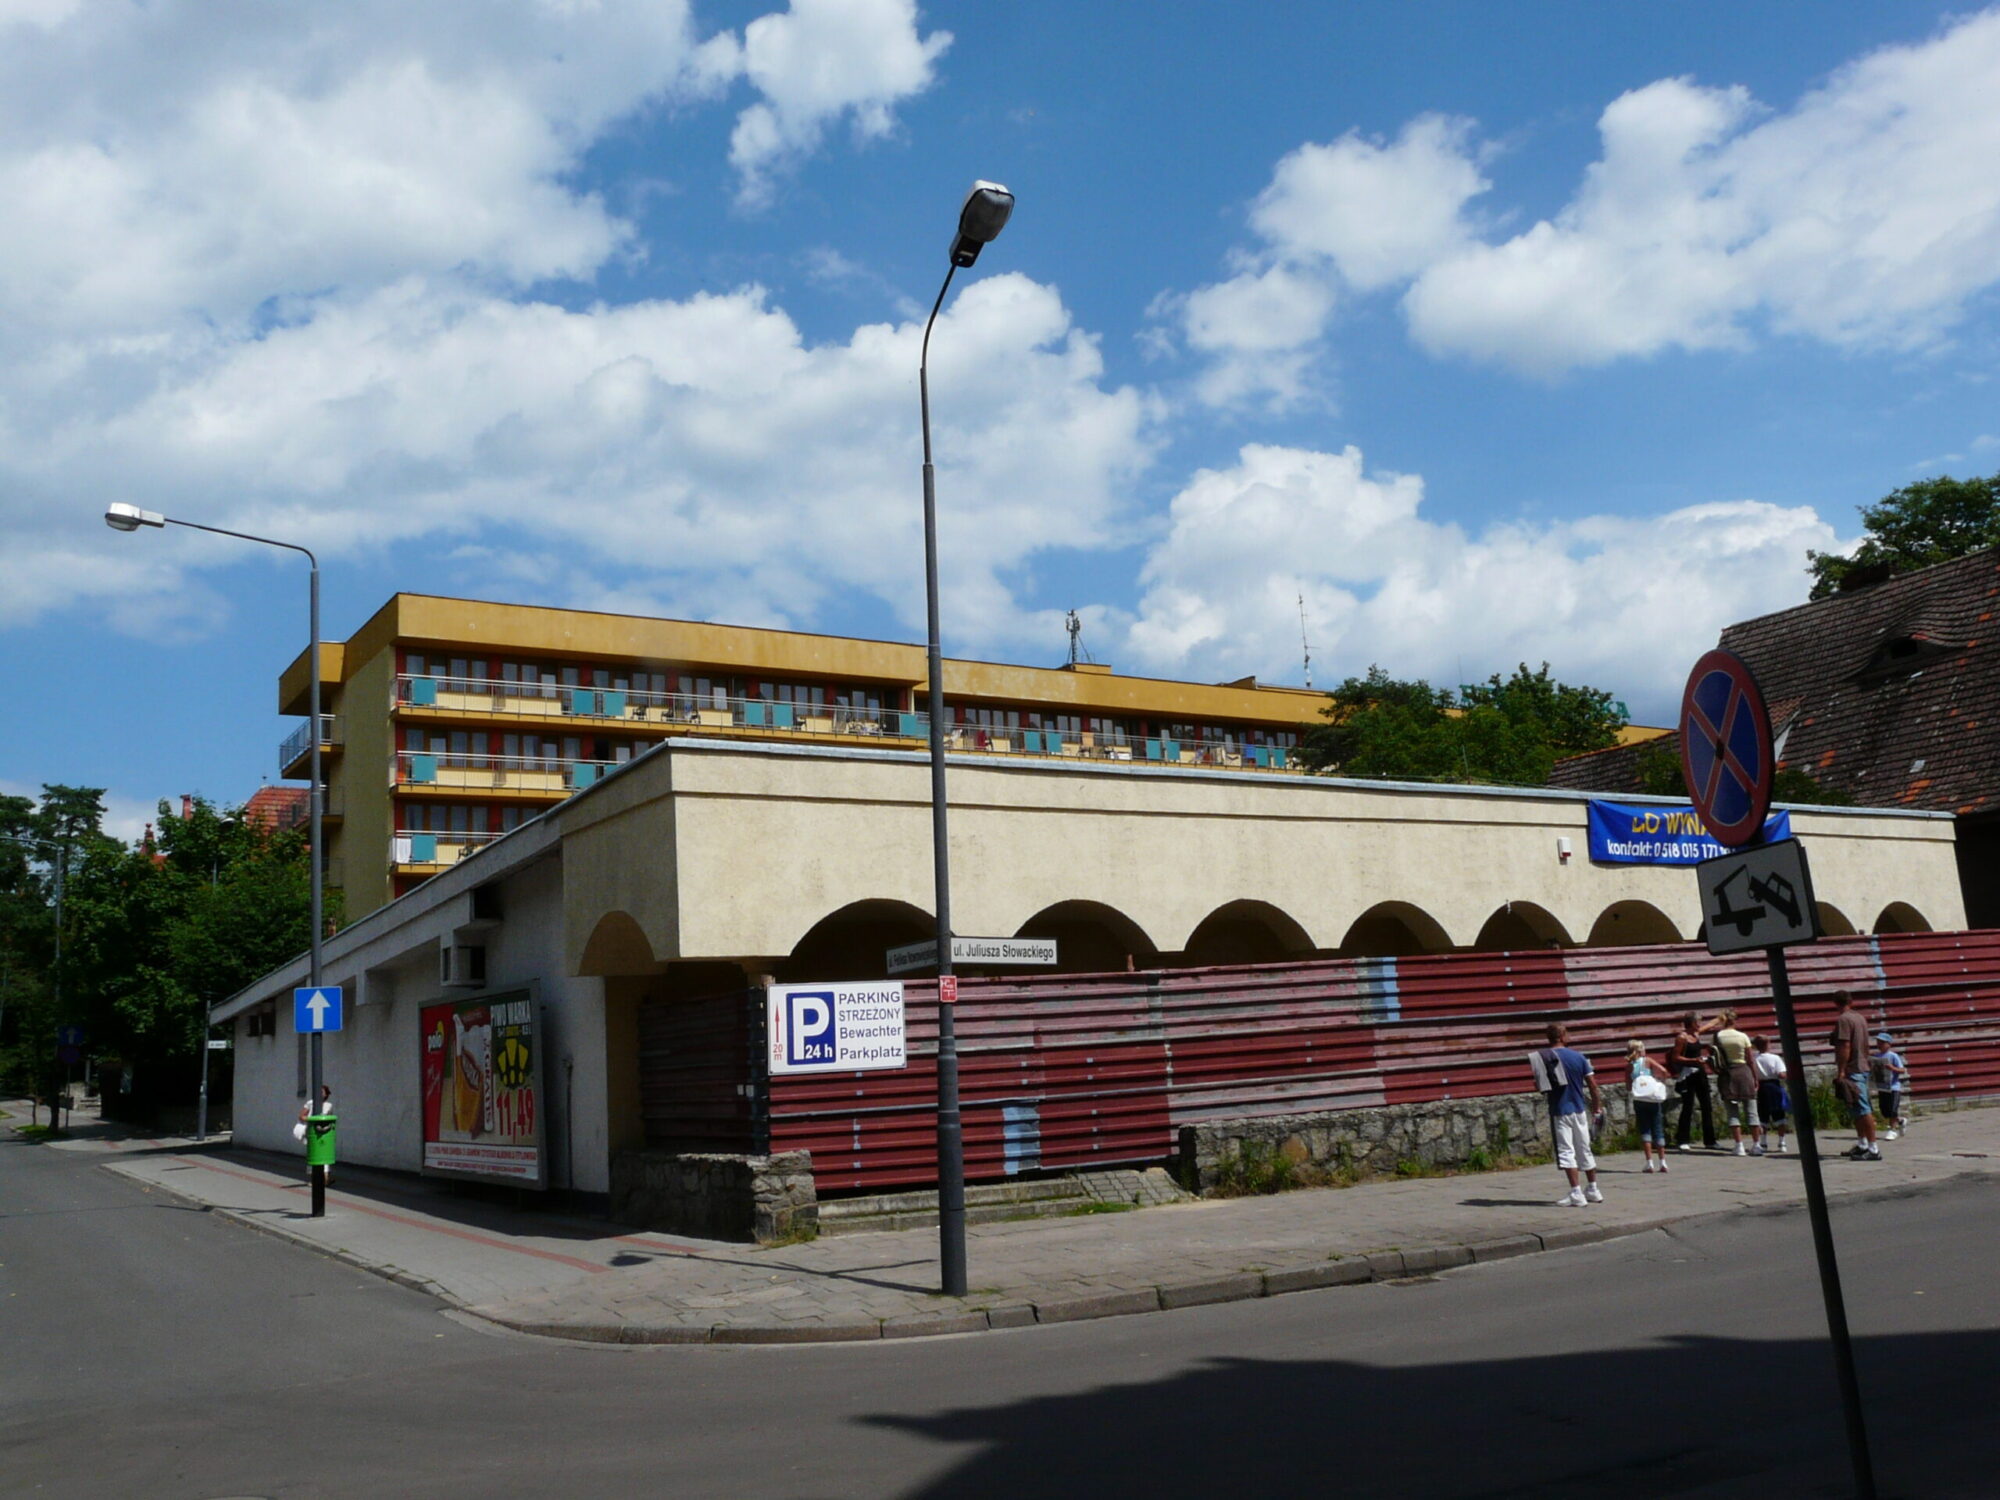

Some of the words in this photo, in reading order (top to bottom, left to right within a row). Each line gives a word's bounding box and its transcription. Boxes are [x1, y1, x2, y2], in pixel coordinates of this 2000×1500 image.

[1607, 839, 1652, 857] kontakt:
[953, 944, 964, 957] ul.
[966, 944, 1000, 958] Juliusza
[1002, 944, 1054, 962] Słowackiego
[839, 991, 901, 1005] PARKING
[839, 1007, 901, 1022] STRZEŻONY
[792, 997, 830, 1061] P
[840, 1026, 902, 1039] Bewachter
[773, 1044, 783, 1053] 20
[805, 1044, 821, 1059] 24
[824, 1043, 833, 1058] h
[840, 1046, 902, 1061] Parkplatz
[774, 1053, 782, 1061] m
